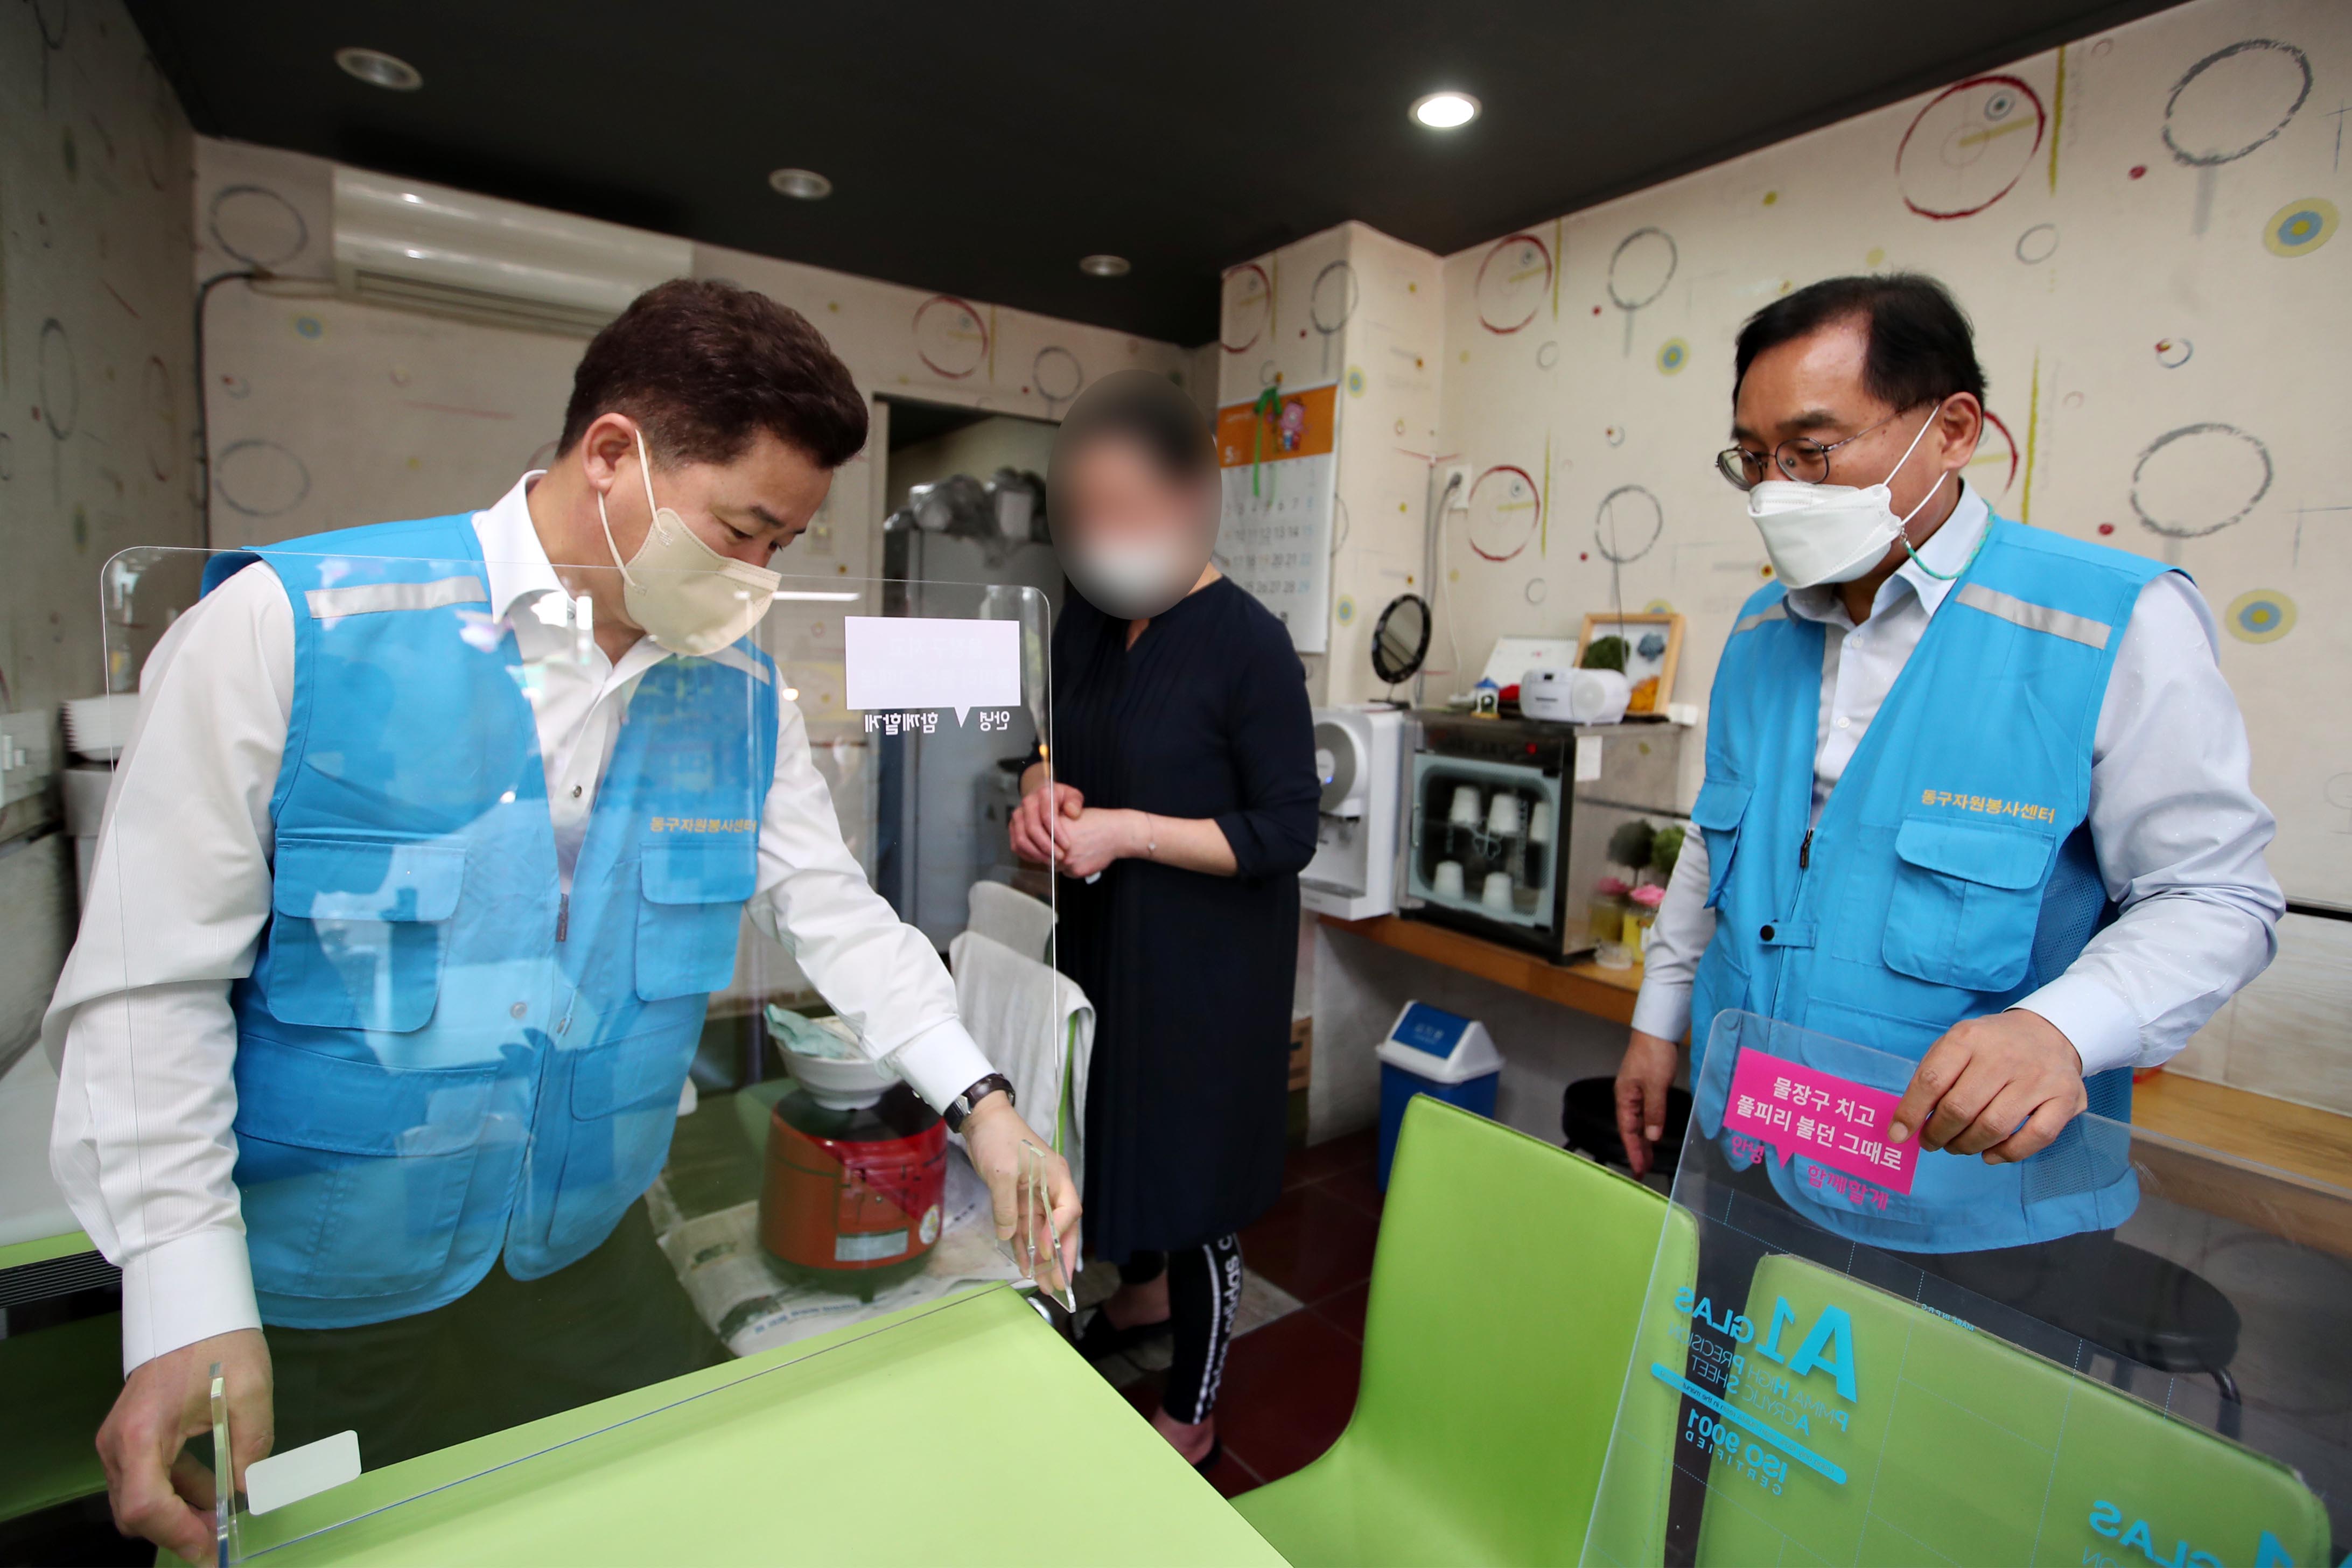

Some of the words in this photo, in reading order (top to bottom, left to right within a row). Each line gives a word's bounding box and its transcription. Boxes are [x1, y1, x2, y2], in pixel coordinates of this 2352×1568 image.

[650, 816, 758, 833] 동구자원봉사센터
[1921, 789, 2056, 824] 동구자원봉사센터
[1773, 1076, 1830, 1111] 물장구
[1835, 1098, 1876, 1128] 치고
[1737, 1094, 1792, 1132] 풀피리
[1796, 1116, 1835, 1147] 불던
[1839, 1132, 1902, 1171] 그때로
[1731, 1136, 1765, 1164] 안녕
[1808, 1165, 1889, 1211] 함께할게
